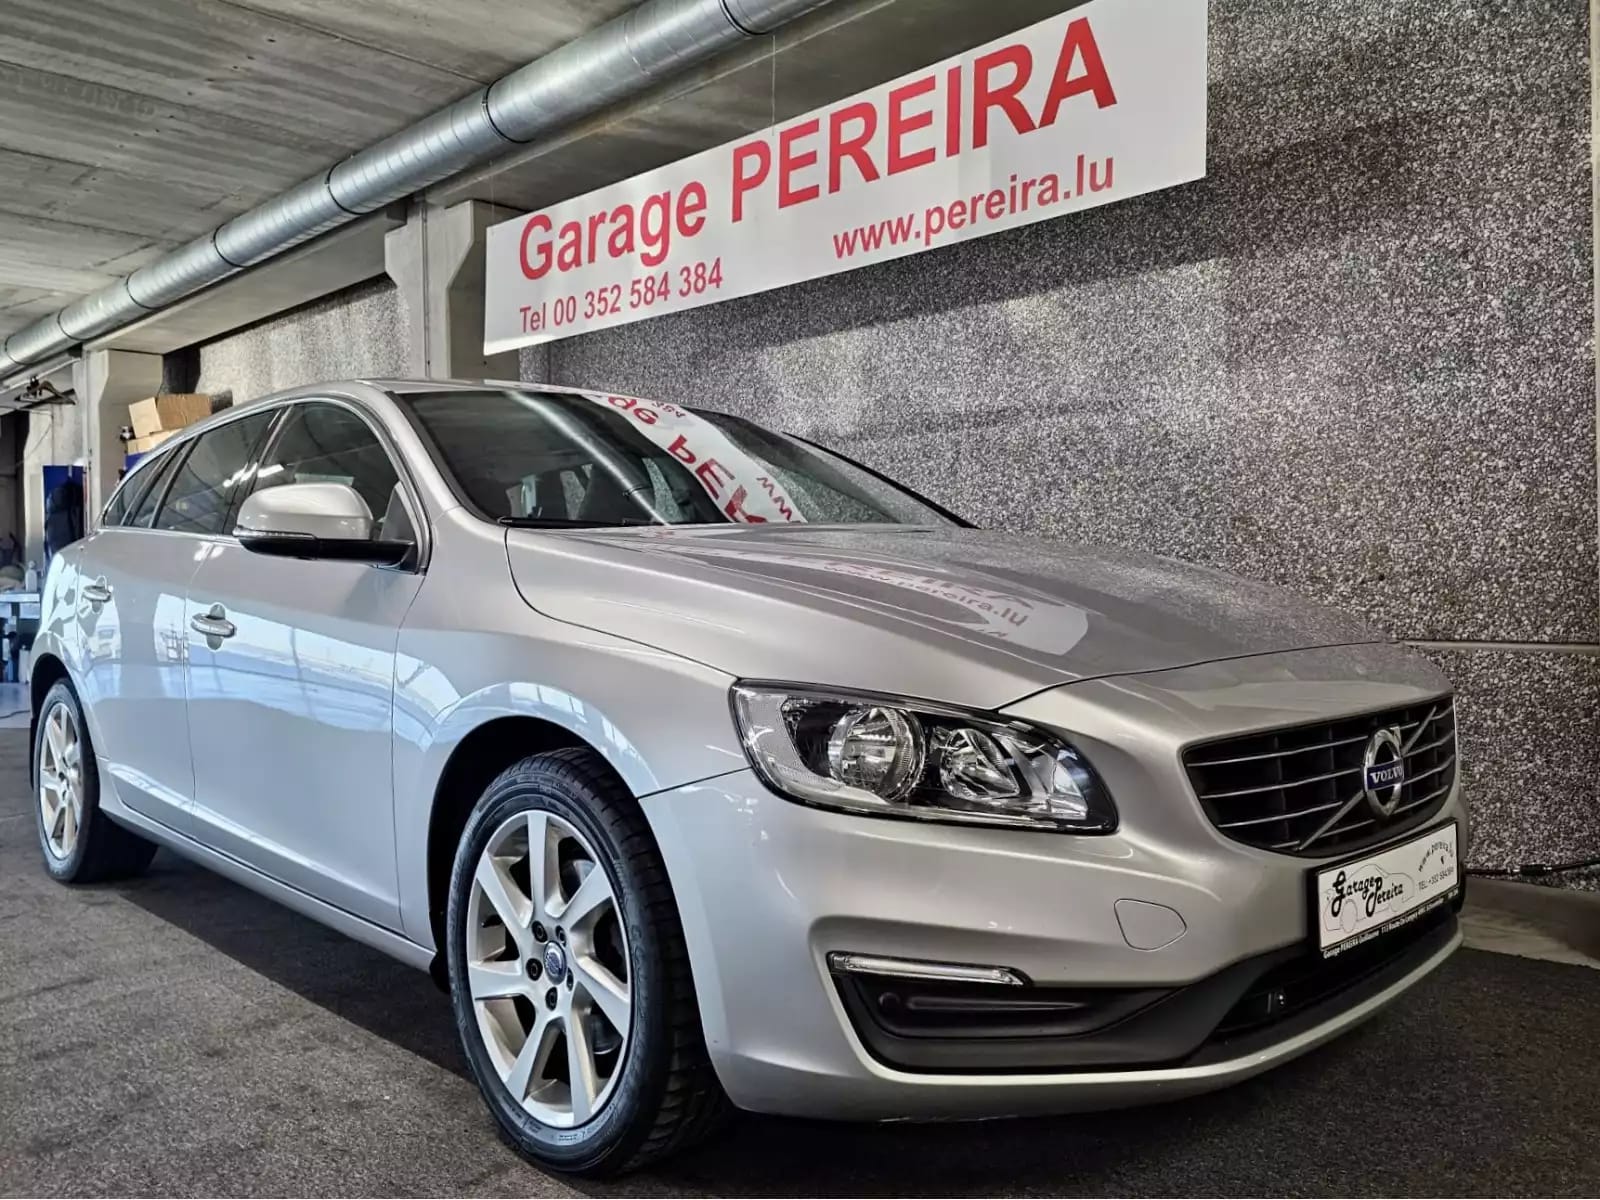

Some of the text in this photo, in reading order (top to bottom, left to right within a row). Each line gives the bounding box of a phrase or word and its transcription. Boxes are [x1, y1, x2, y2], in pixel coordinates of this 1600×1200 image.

[519, 16, 1118, 281] Garage PEREIRA
[832, 154, 1115, 259] www.pereira.lu
[520, 257, 723, 333] Tel 00 352 584 384
[1370, 766, 1403, 784] VOLVO
[1365, 876, 1404, 918] Pereira
